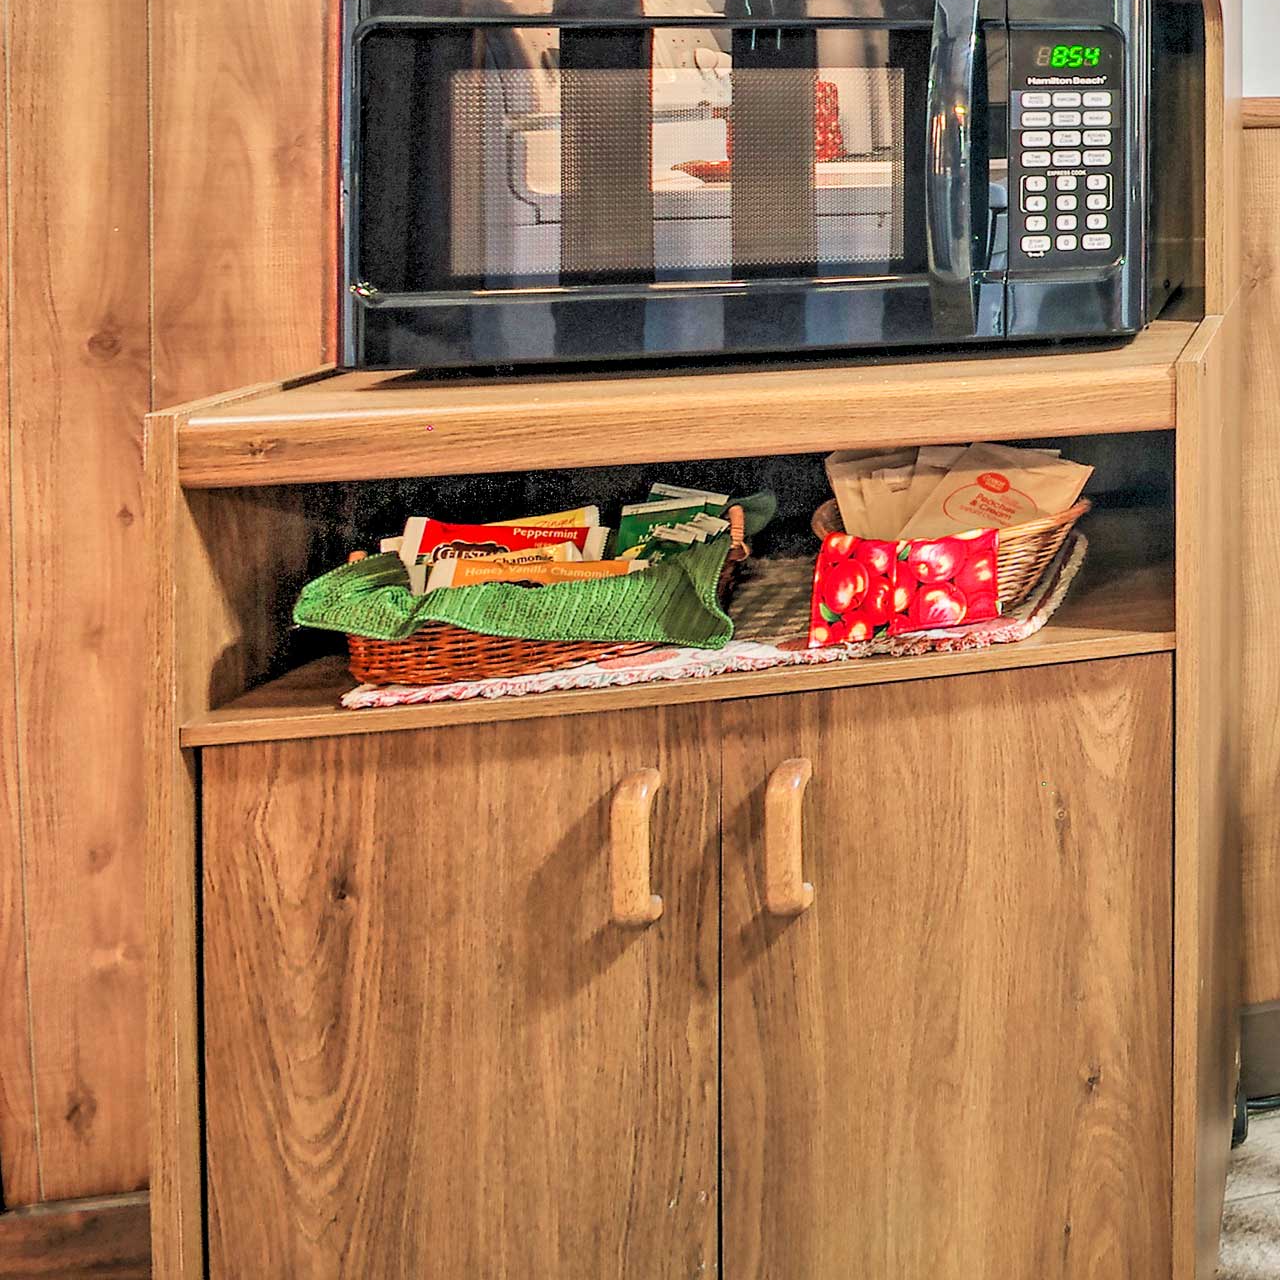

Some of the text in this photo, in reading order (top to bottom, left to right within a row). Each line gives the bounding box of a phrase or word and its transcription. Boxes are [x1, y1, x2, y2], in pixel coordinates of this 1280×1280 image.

[1027, 76, 1072, 85] Hamilton
[976, 492, 1015, 514] Peaches
[979, 503, 1012, 520] Cream
[513, 527, 578, 540] Peppermint
[464, 565, 615, 579] Honey Vanilla Chamomile
